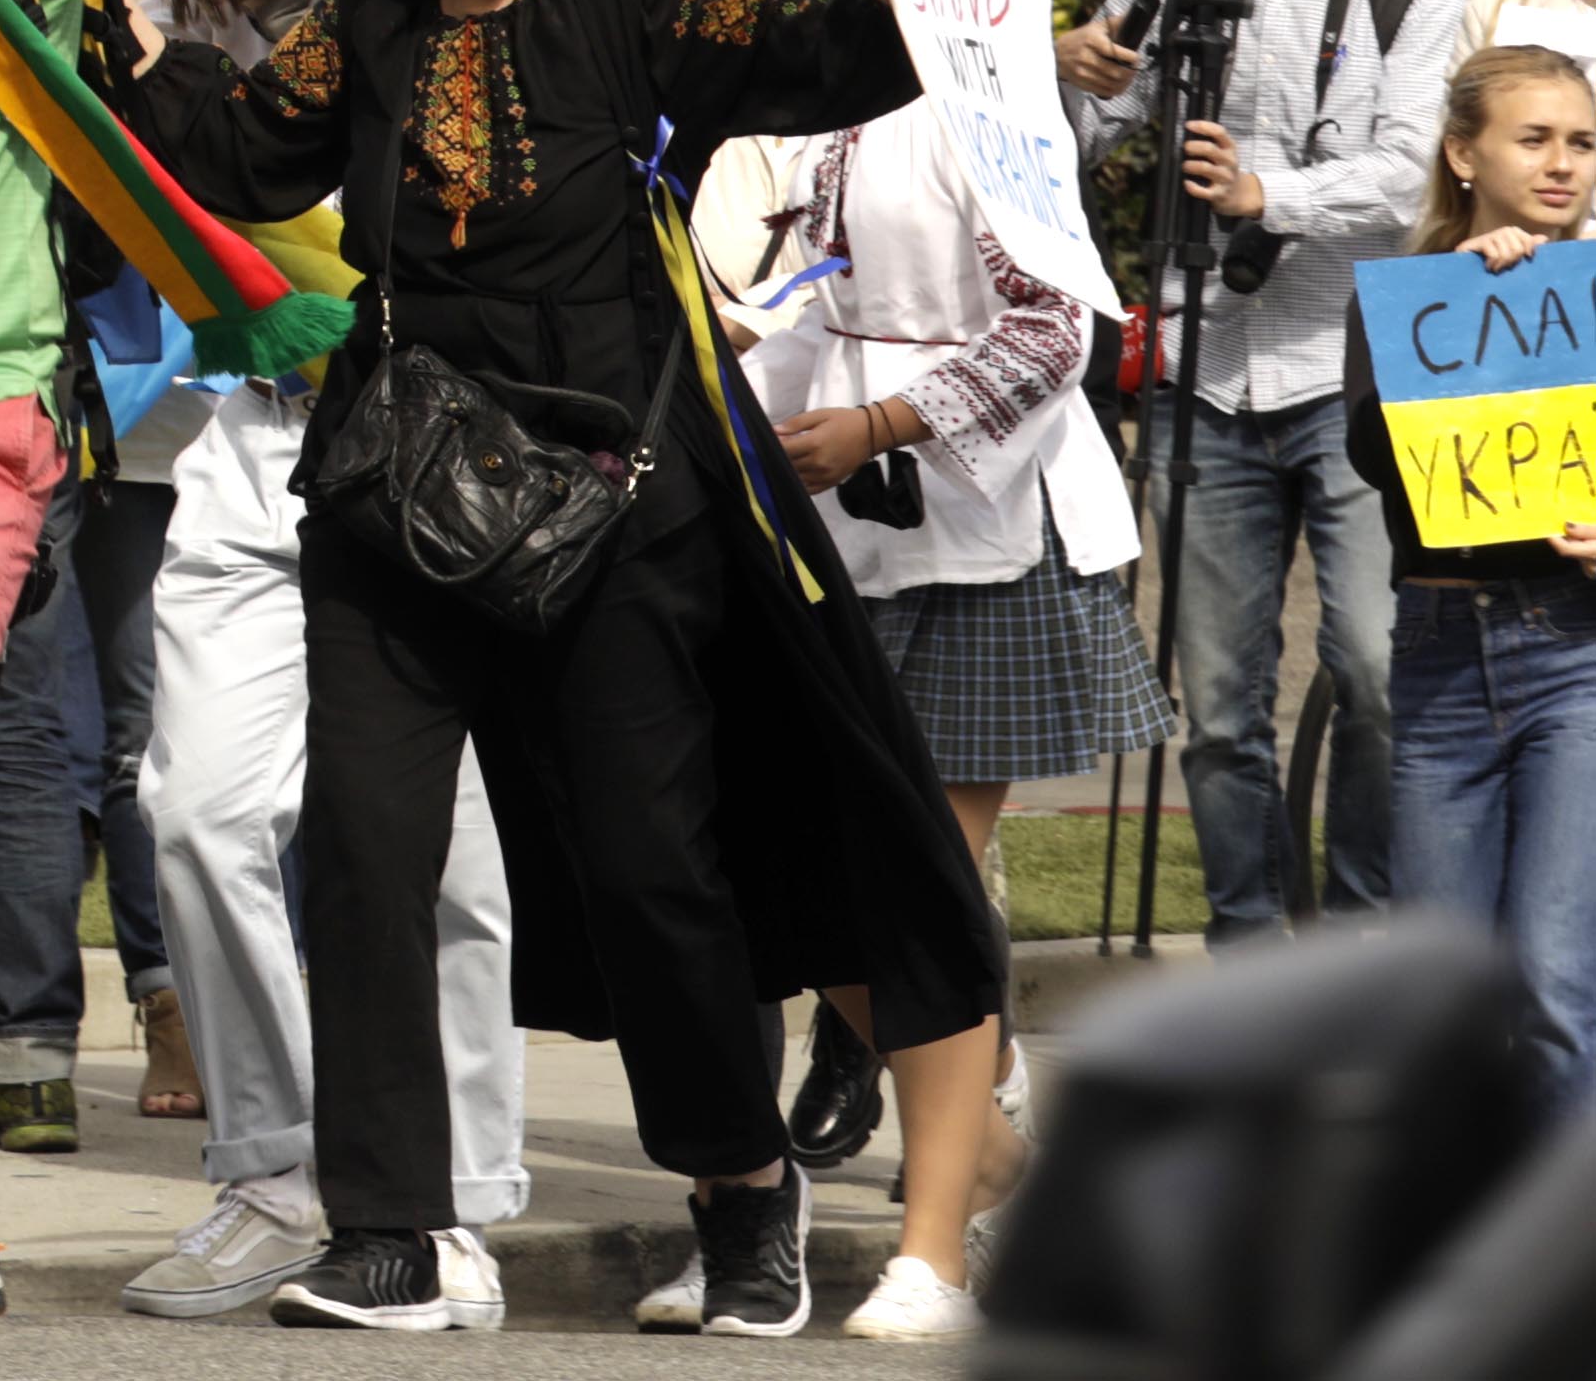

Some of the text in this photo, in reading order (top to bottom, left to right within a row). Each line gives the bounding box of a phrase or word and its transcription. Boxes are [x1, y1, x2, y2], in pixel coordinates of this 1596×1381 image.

[935, 32, 1005, 105] WITH
[1412, 284, 1596, 376] СЛА
[1407, 418, 1596, 521] УКРА
